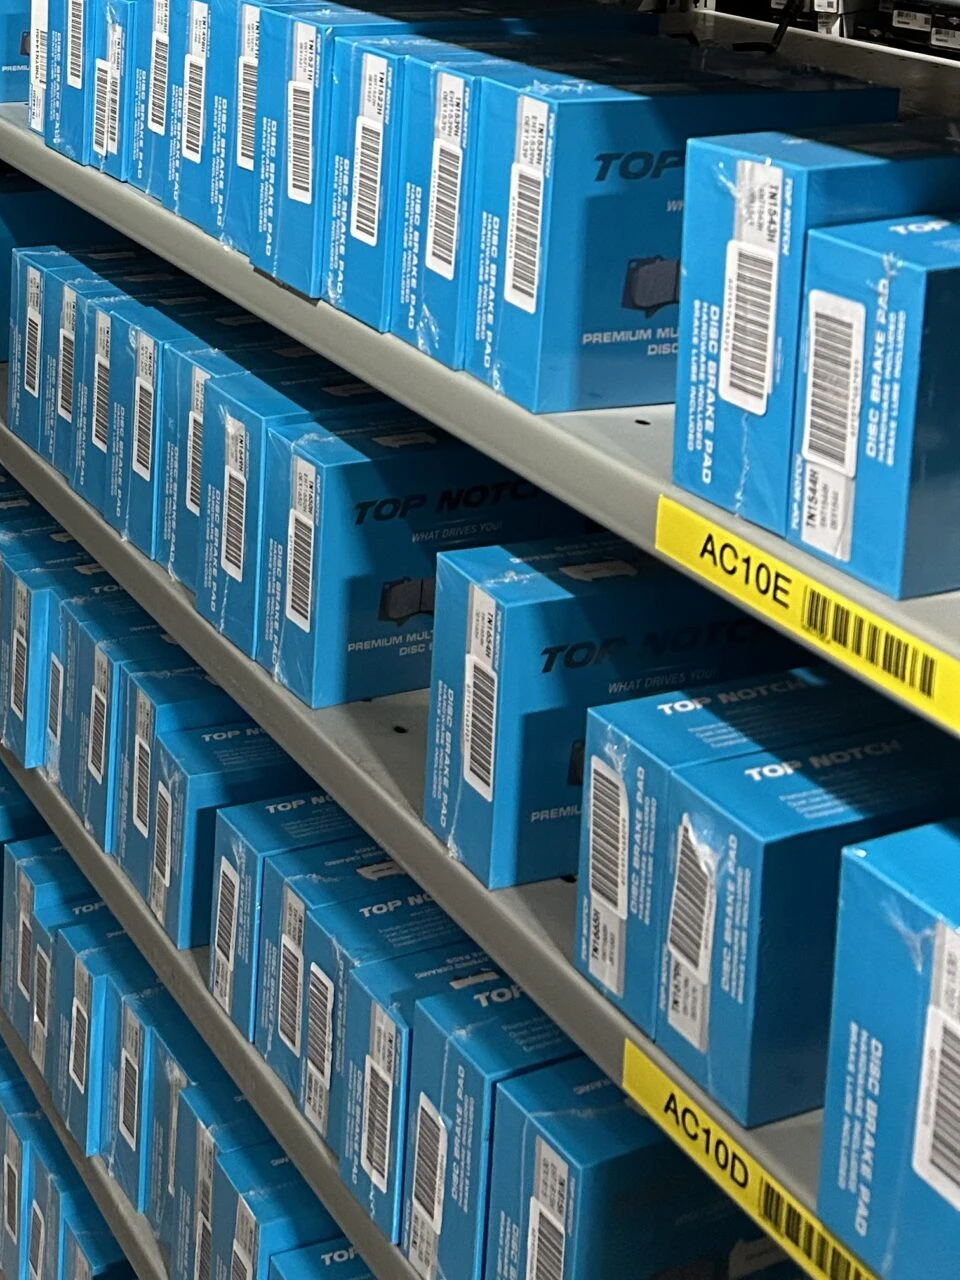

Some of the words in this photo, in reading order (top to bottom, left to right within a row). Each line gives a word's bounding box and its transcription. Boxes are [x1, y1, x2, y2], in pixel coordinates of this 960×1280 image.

[376, 71, 385, 115] TN1522H
[414, 186, 422, 226] DISC
[491, 216, 500, 258] DISC
[410, 230, 420, 292] BRAKE
[408, 297, 416, 330] PAD
[487, 265, 498, 327] BRAKE
[582, 328, 652, 345] PREMIUM
[692, 299, 701, 345] BRAKE
[699, 302, 708, 380] HARDWARE
[709, 304, 720, 354] DISC
[483, 332, 492, 368] PAD
[690, 348, 698, 382] LUBE
[870, 330, 886, 403] BRAKE
[688, 386, 696, 450] INCLUDED
[696, 384, 704, 450] INCLUDED
[705, 362, 717, 432] BRAKE
[866, 408, 878, 458] DISC
[701, 440, 713, 484] PAD
[435, 480, 539, 513] NOTC
[699, 533, 793, 610] AC10E
[348, 636, 402, 652] PREMIUM
[400, 644, 424, 656] DISC
[657, 696, 714, 716] TOP
[744, 760, 804, 782] TOP
[265, 799, 305, 814] TOP
[360, 900, 402, 918] TOP
[868, 1038, 882, 1096] DISC
[664, 1093, 749, 1189] AC10D
[860, 1102, 878, 1180] BRAKE
[854, 1186, 871, 1237] PAD
